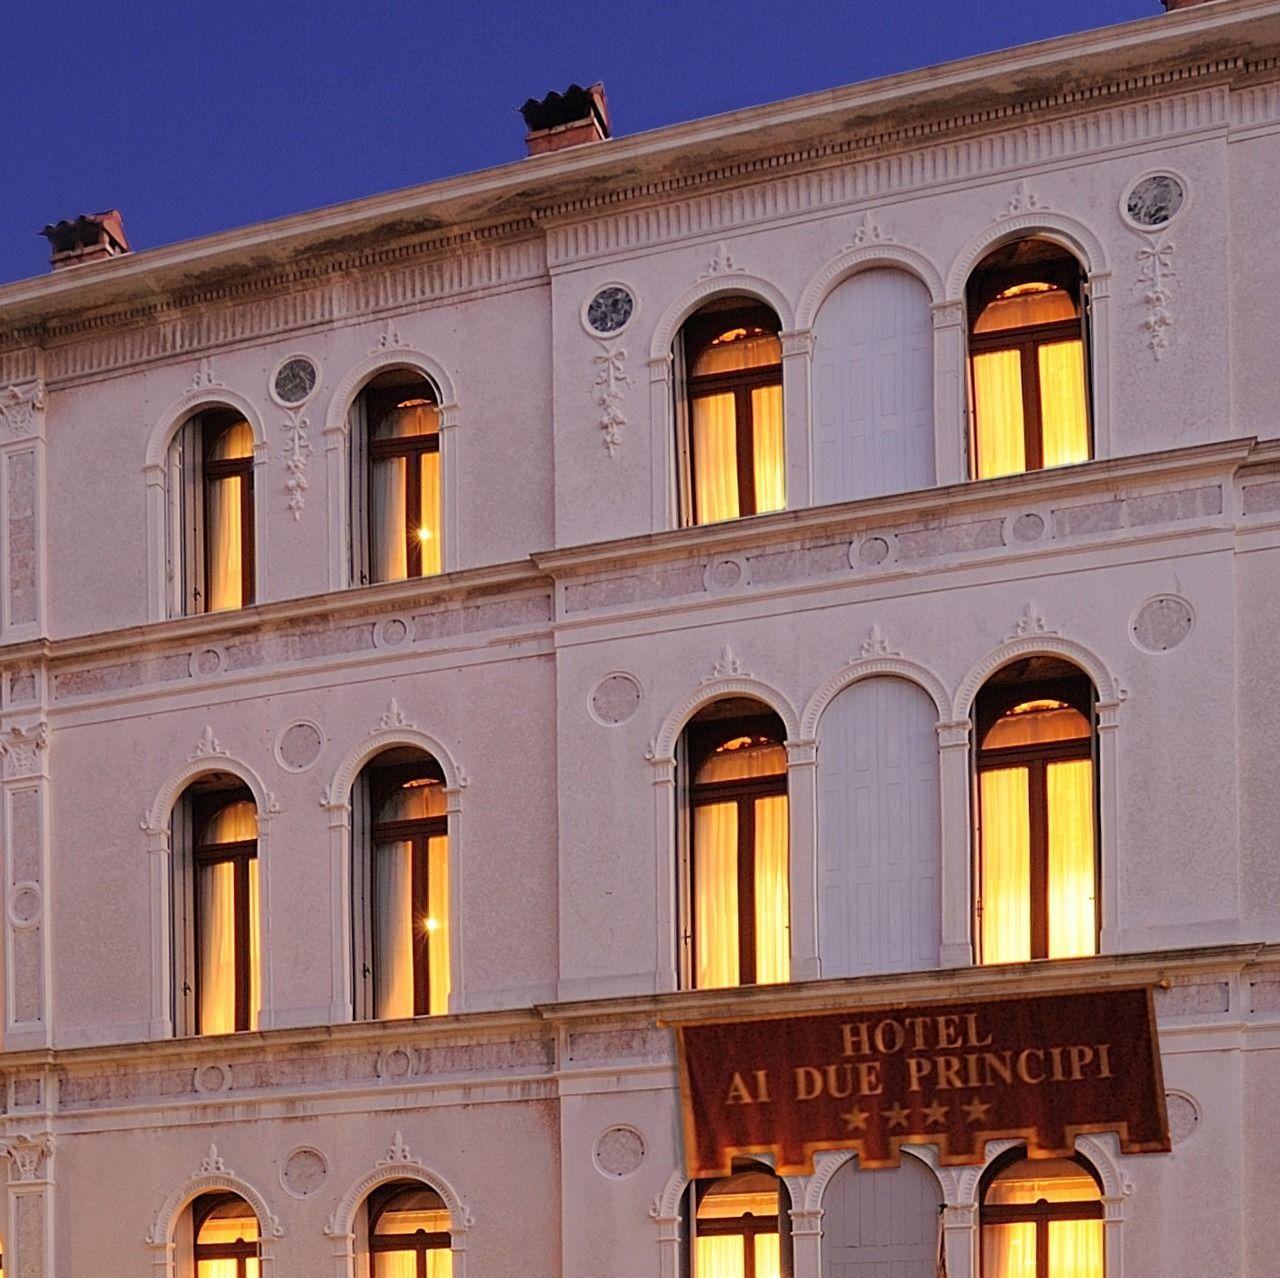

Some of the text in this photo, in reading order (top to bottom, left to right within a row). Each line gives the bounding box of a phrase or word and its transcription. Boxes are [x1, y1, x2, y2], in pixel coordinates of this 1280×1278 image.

[839, 1011, 993, 1058] HOTEL
[726, 1043, 1114, 1106] AI DUE PRINCIPI
